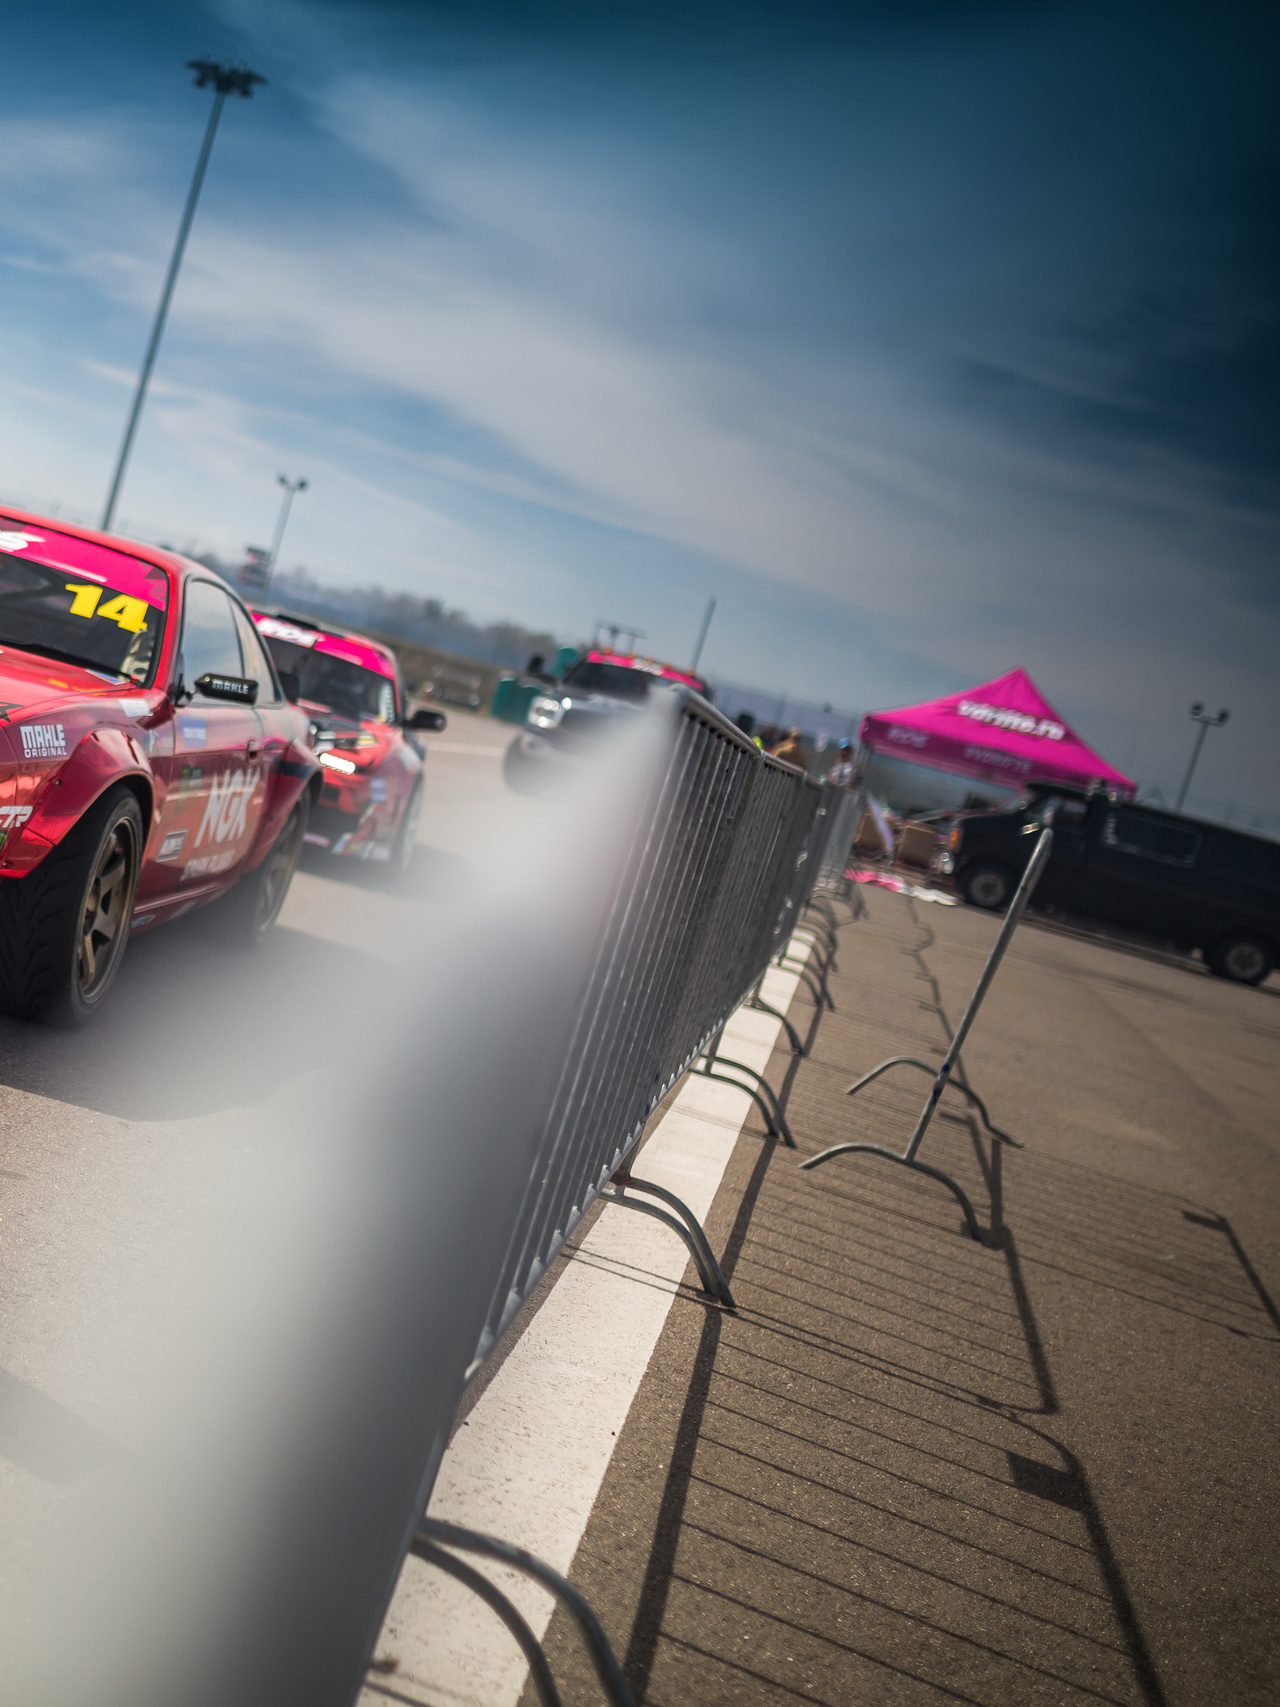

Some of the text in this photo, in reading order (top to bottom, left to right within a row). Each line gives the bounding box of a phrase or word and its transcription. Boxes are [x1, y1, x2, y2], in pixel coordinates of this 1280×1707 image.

[66, 583, 148, 633] 14
[20, 724, 66, 749] MAHLE
[24, 747, 68, 759] ORIGINAL
[193, 767, 262, 849] NGK
